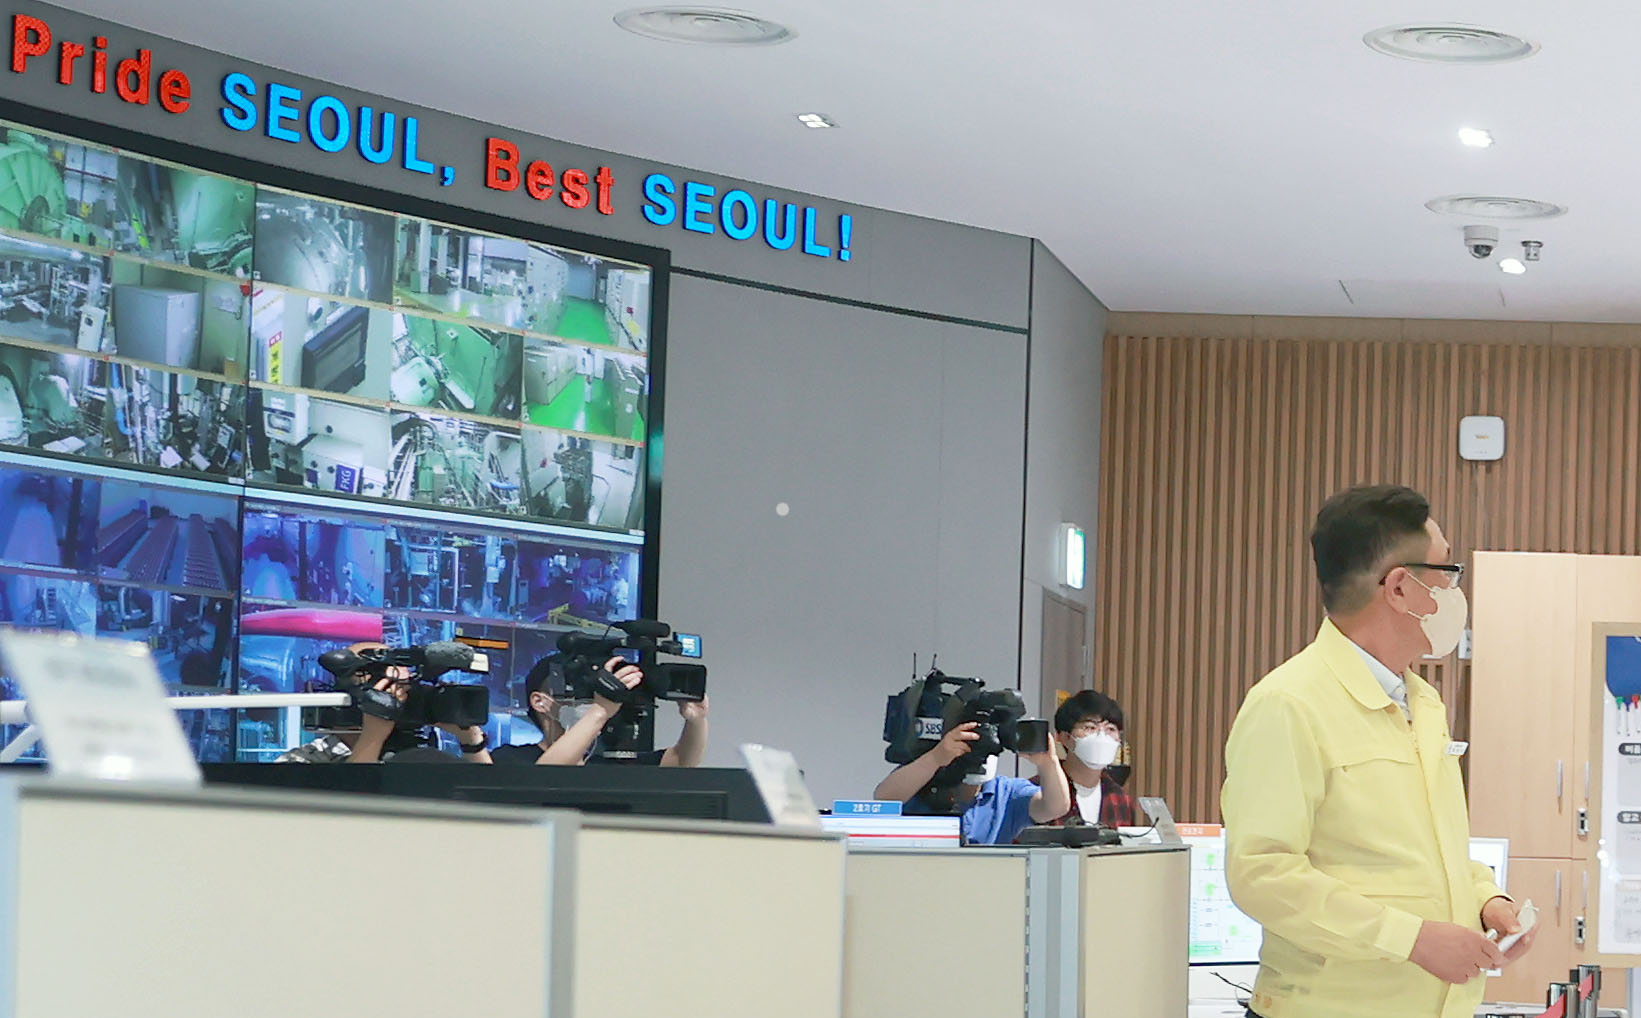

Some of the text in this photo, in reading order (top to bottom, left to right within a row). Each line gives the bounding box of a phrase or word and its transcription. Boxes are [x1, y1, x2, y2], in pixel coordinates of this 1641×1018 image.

[10, 13, 853, 262] Pride SEOUL, Best SEOUL!
